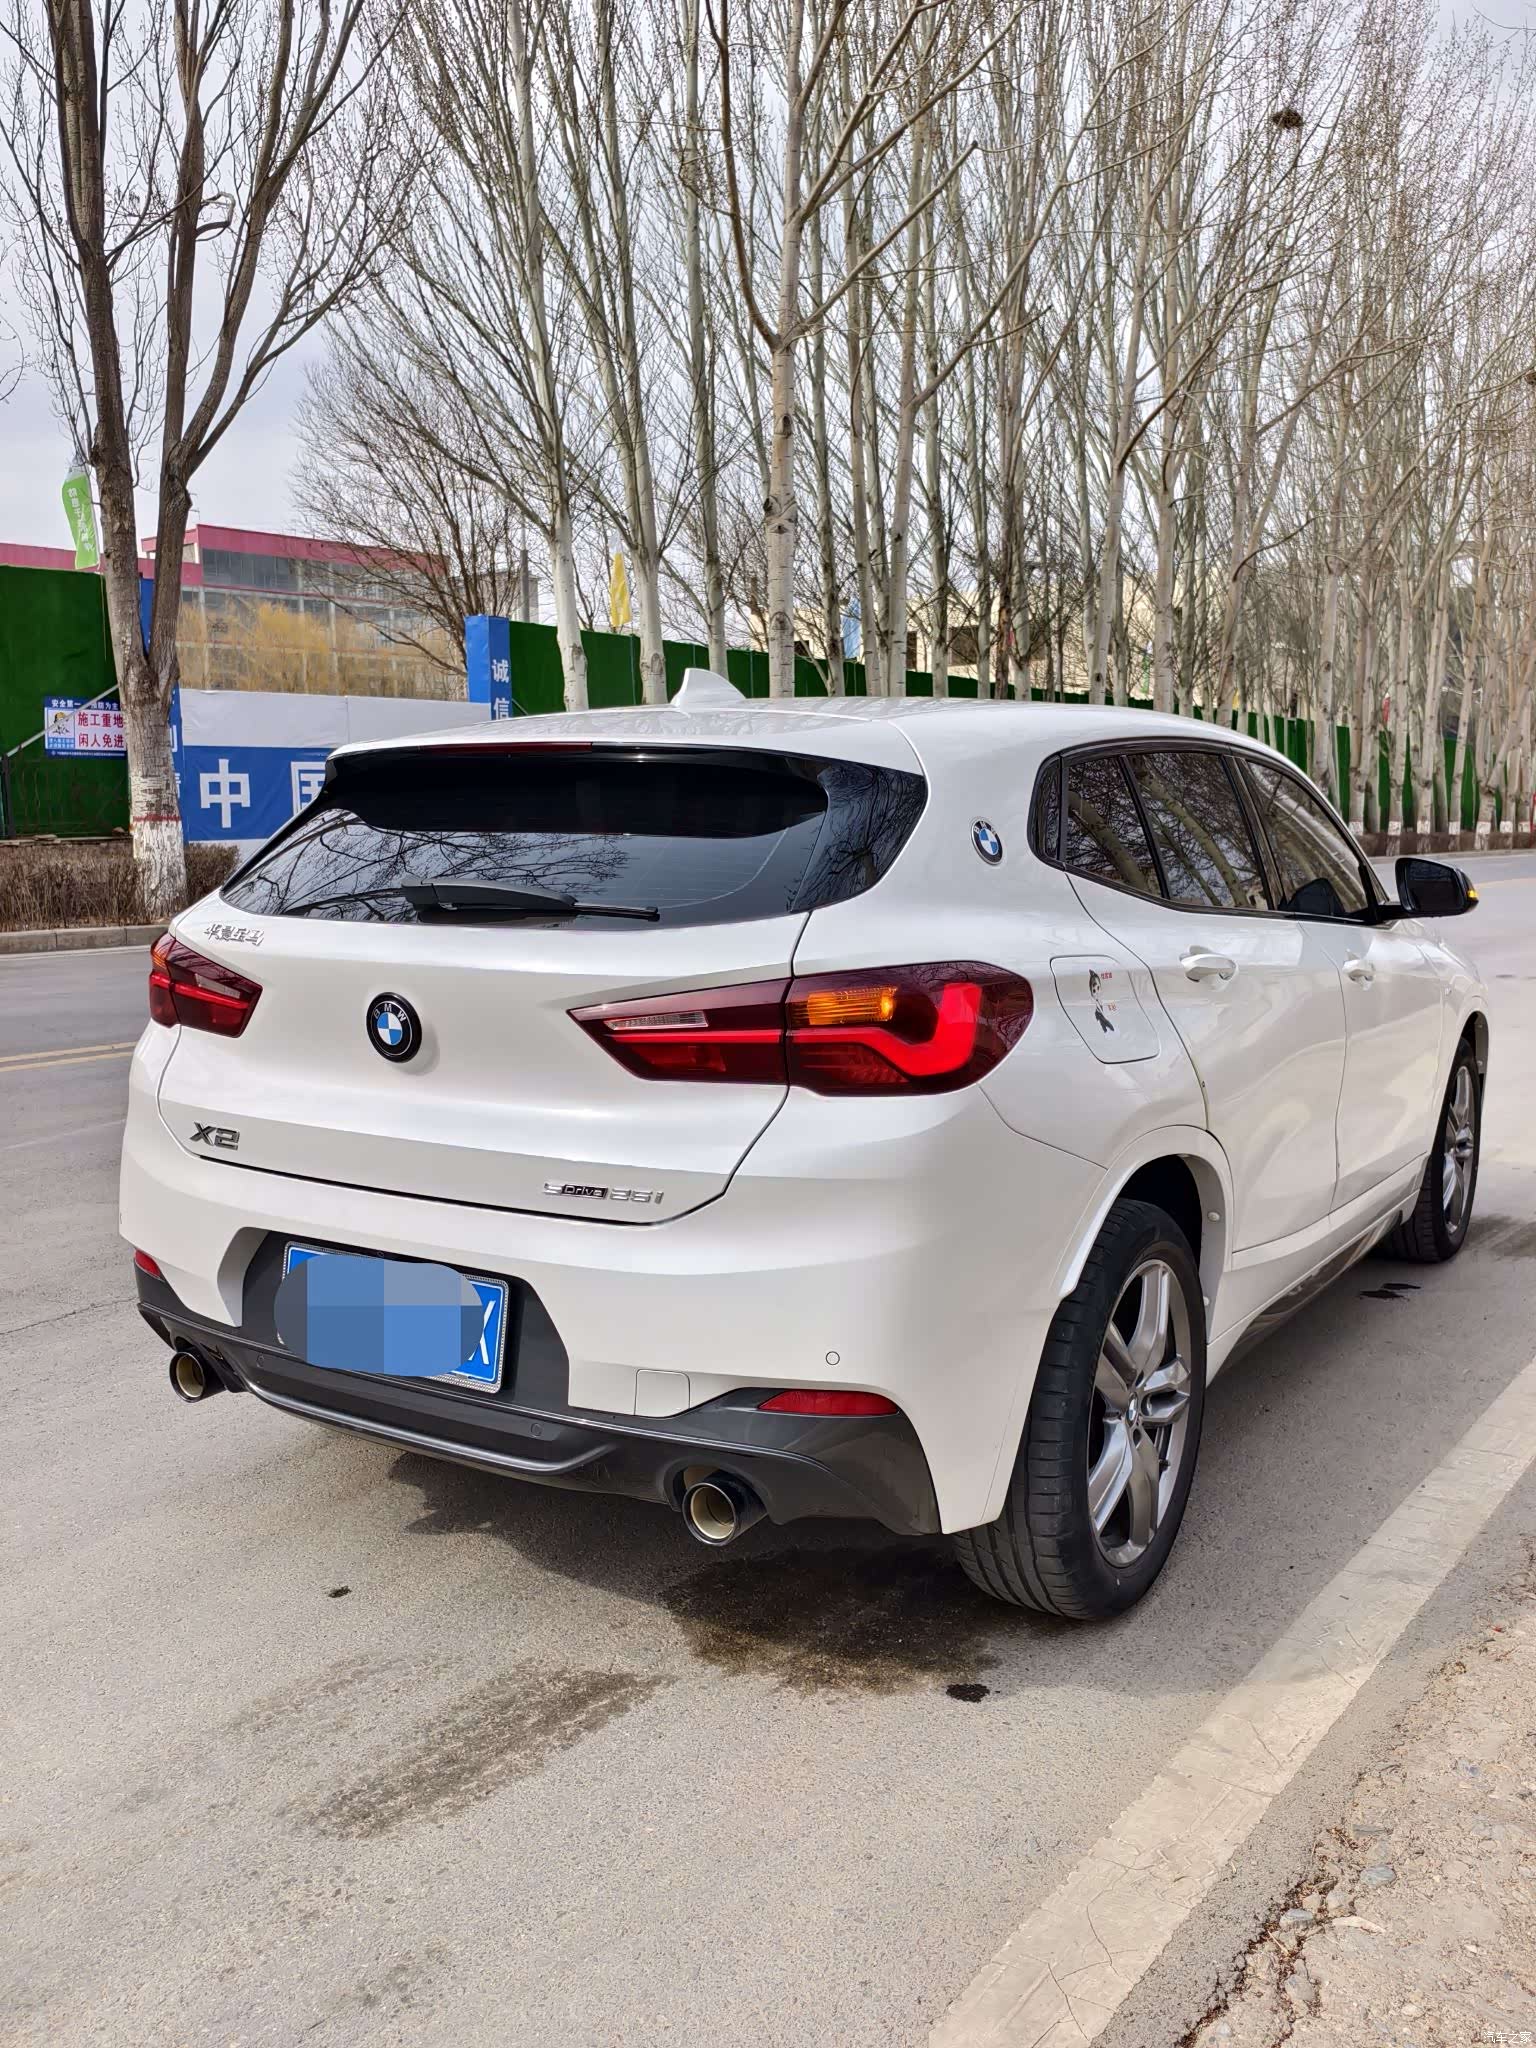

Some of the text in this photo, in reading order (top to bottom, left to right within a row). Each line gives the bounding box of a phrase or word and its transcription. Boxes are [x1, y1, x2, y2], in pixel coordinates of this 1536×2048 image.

[492, 659, 510, 720] 诚信
[52, 699, 81, 708] 安全第一
[78, 712, 124, 728] 施工重地
[78, 733, 124, 748] 闲人免进
[204, 924, 265, 946] 华晨宝马
[373, 1003, 407, 1022] BMW
[189, 1121, 241, 1151] X2
[610, 1187, 665, 1205] 25i
